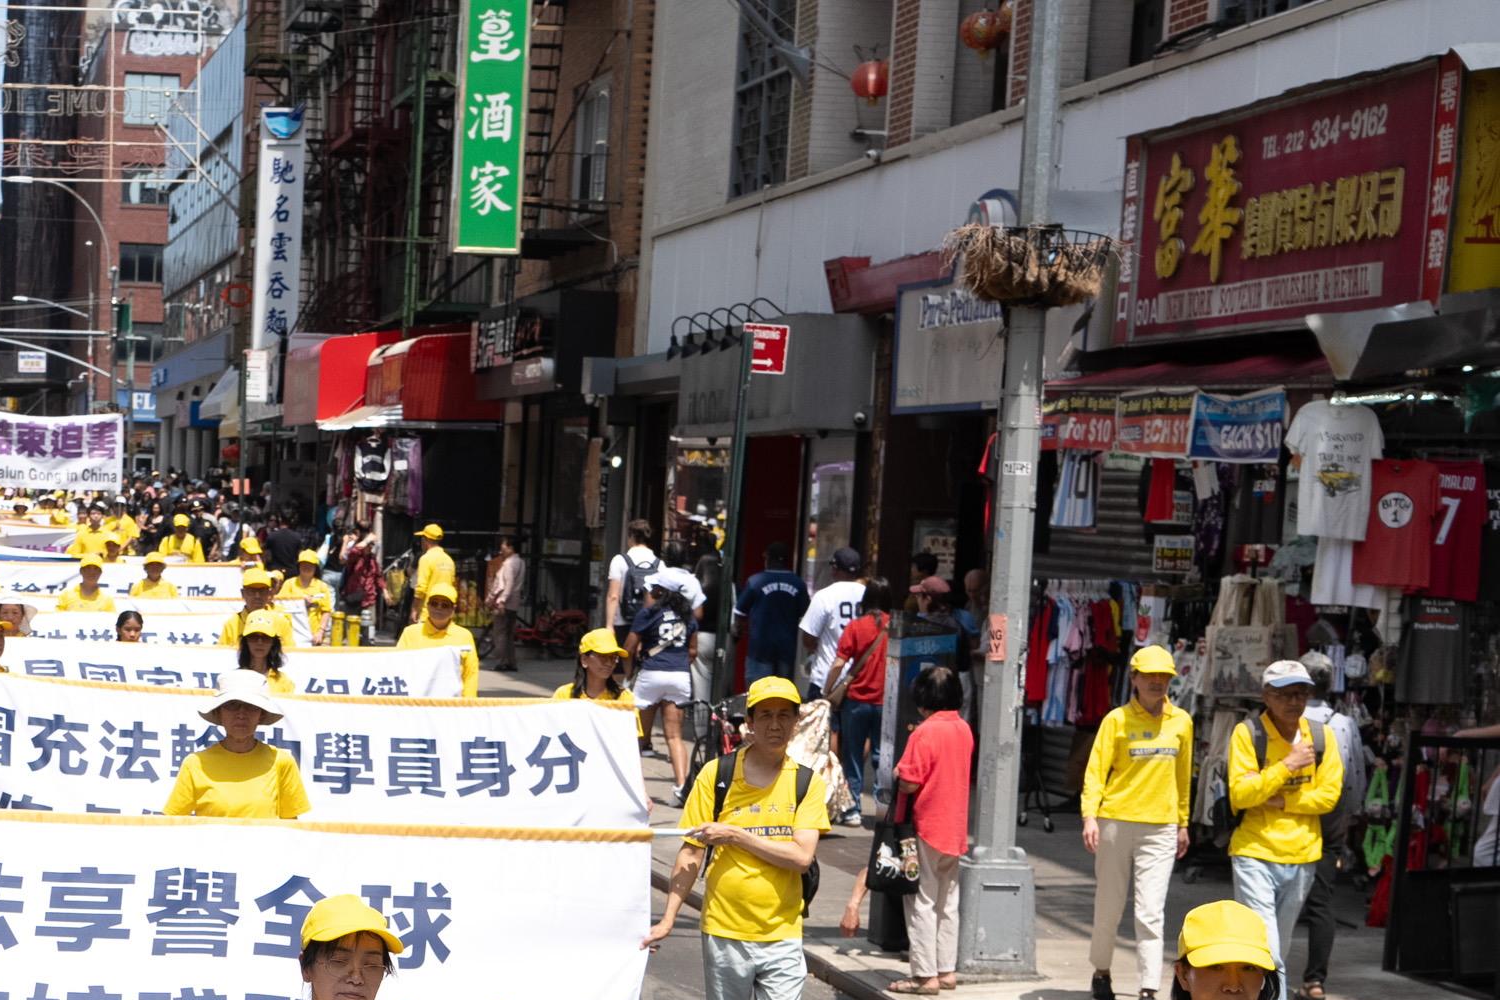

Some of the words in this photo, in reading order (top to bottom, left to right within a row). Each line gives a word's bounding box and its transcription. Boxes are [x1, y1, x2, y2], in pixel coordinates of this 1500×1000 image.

[1310, 103, 1388, 150] 334-9162
[1065, 419, 1086, 442] For
[1088, 419, 1111, 445] $10
[1255, 421, 1282, 449] $10
[1325, 432, 1364, 443] SURVIVED
[1319, 453, 1337, 463] TRIP
[28, 468, 62, 485] Gong
[66, 467, 77, 482] in
[82, 467, 117, 483] China
[1381, 497, 1411, 511] BITCH
[1392, 510, 1399, 523] 1
[1435, 496, 1461, 545] 7
[761, 582, 777, 596] NEW
[779, 581, 799, 597] YORK
[768, 826, 792, 836] DAFA
